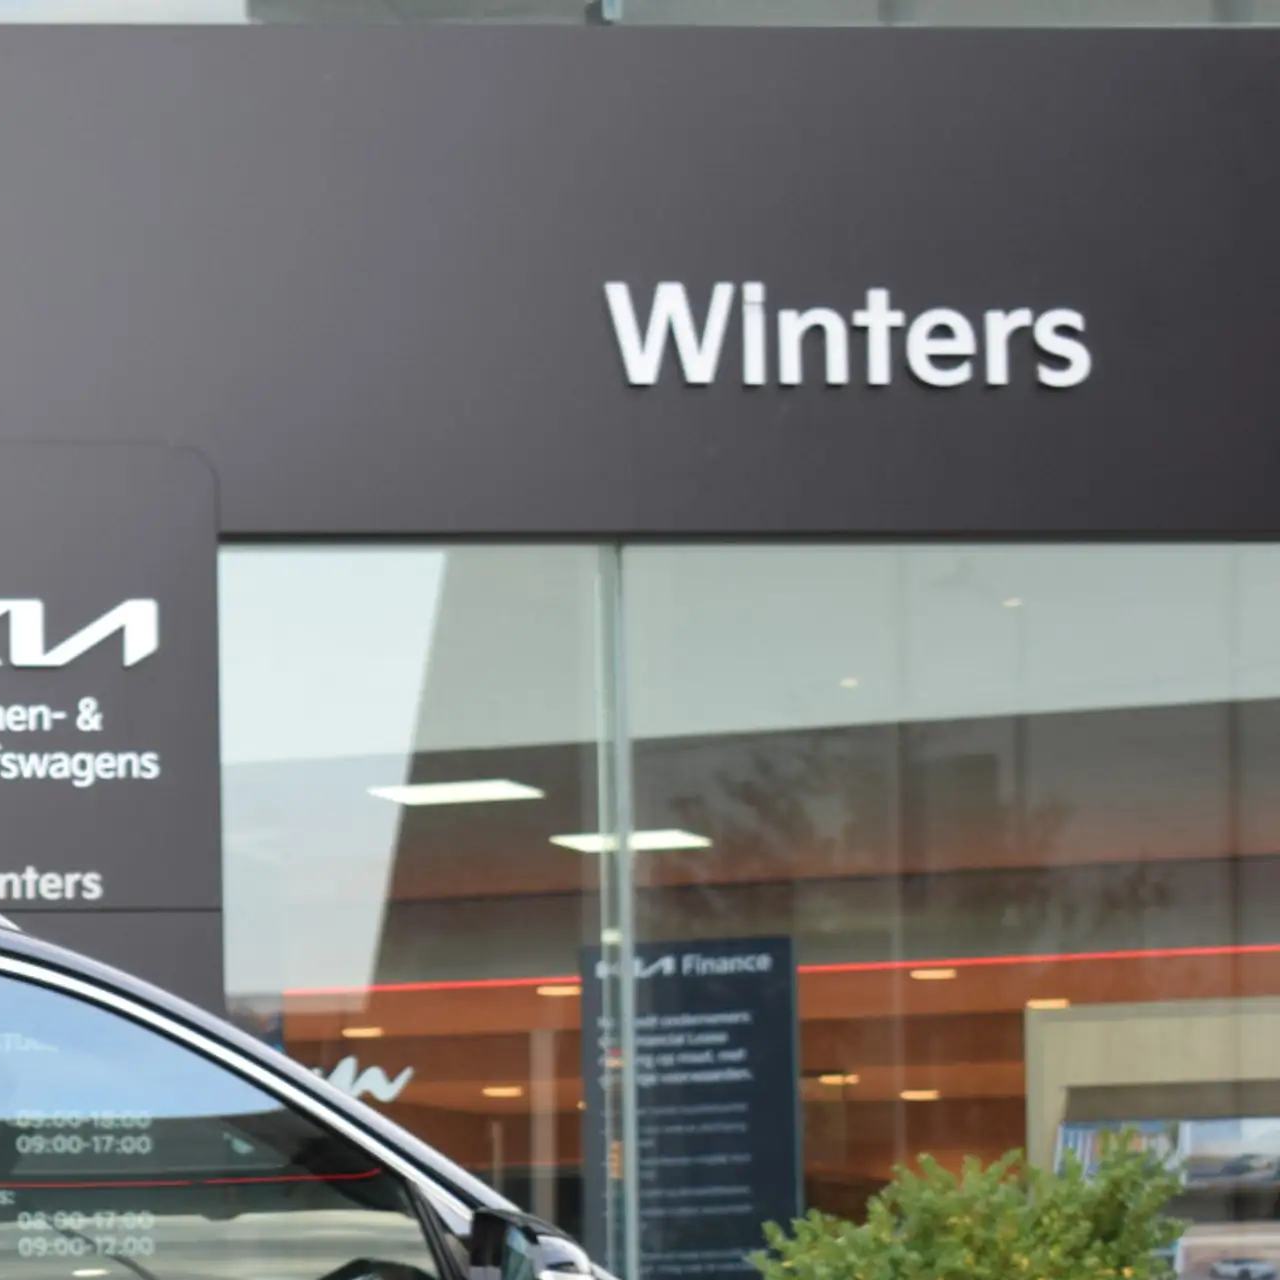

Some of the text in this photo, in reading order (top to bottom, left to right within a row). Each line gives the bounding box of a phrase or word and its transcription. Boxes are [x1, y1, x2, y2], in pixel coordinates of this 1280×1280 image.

[604, 282, 1092, 387] Winters
[76, 697, 103, 732] &
[682, 953, 773, 976] Finance
[15, 1133, 153, 1155] 09:00-17:00
